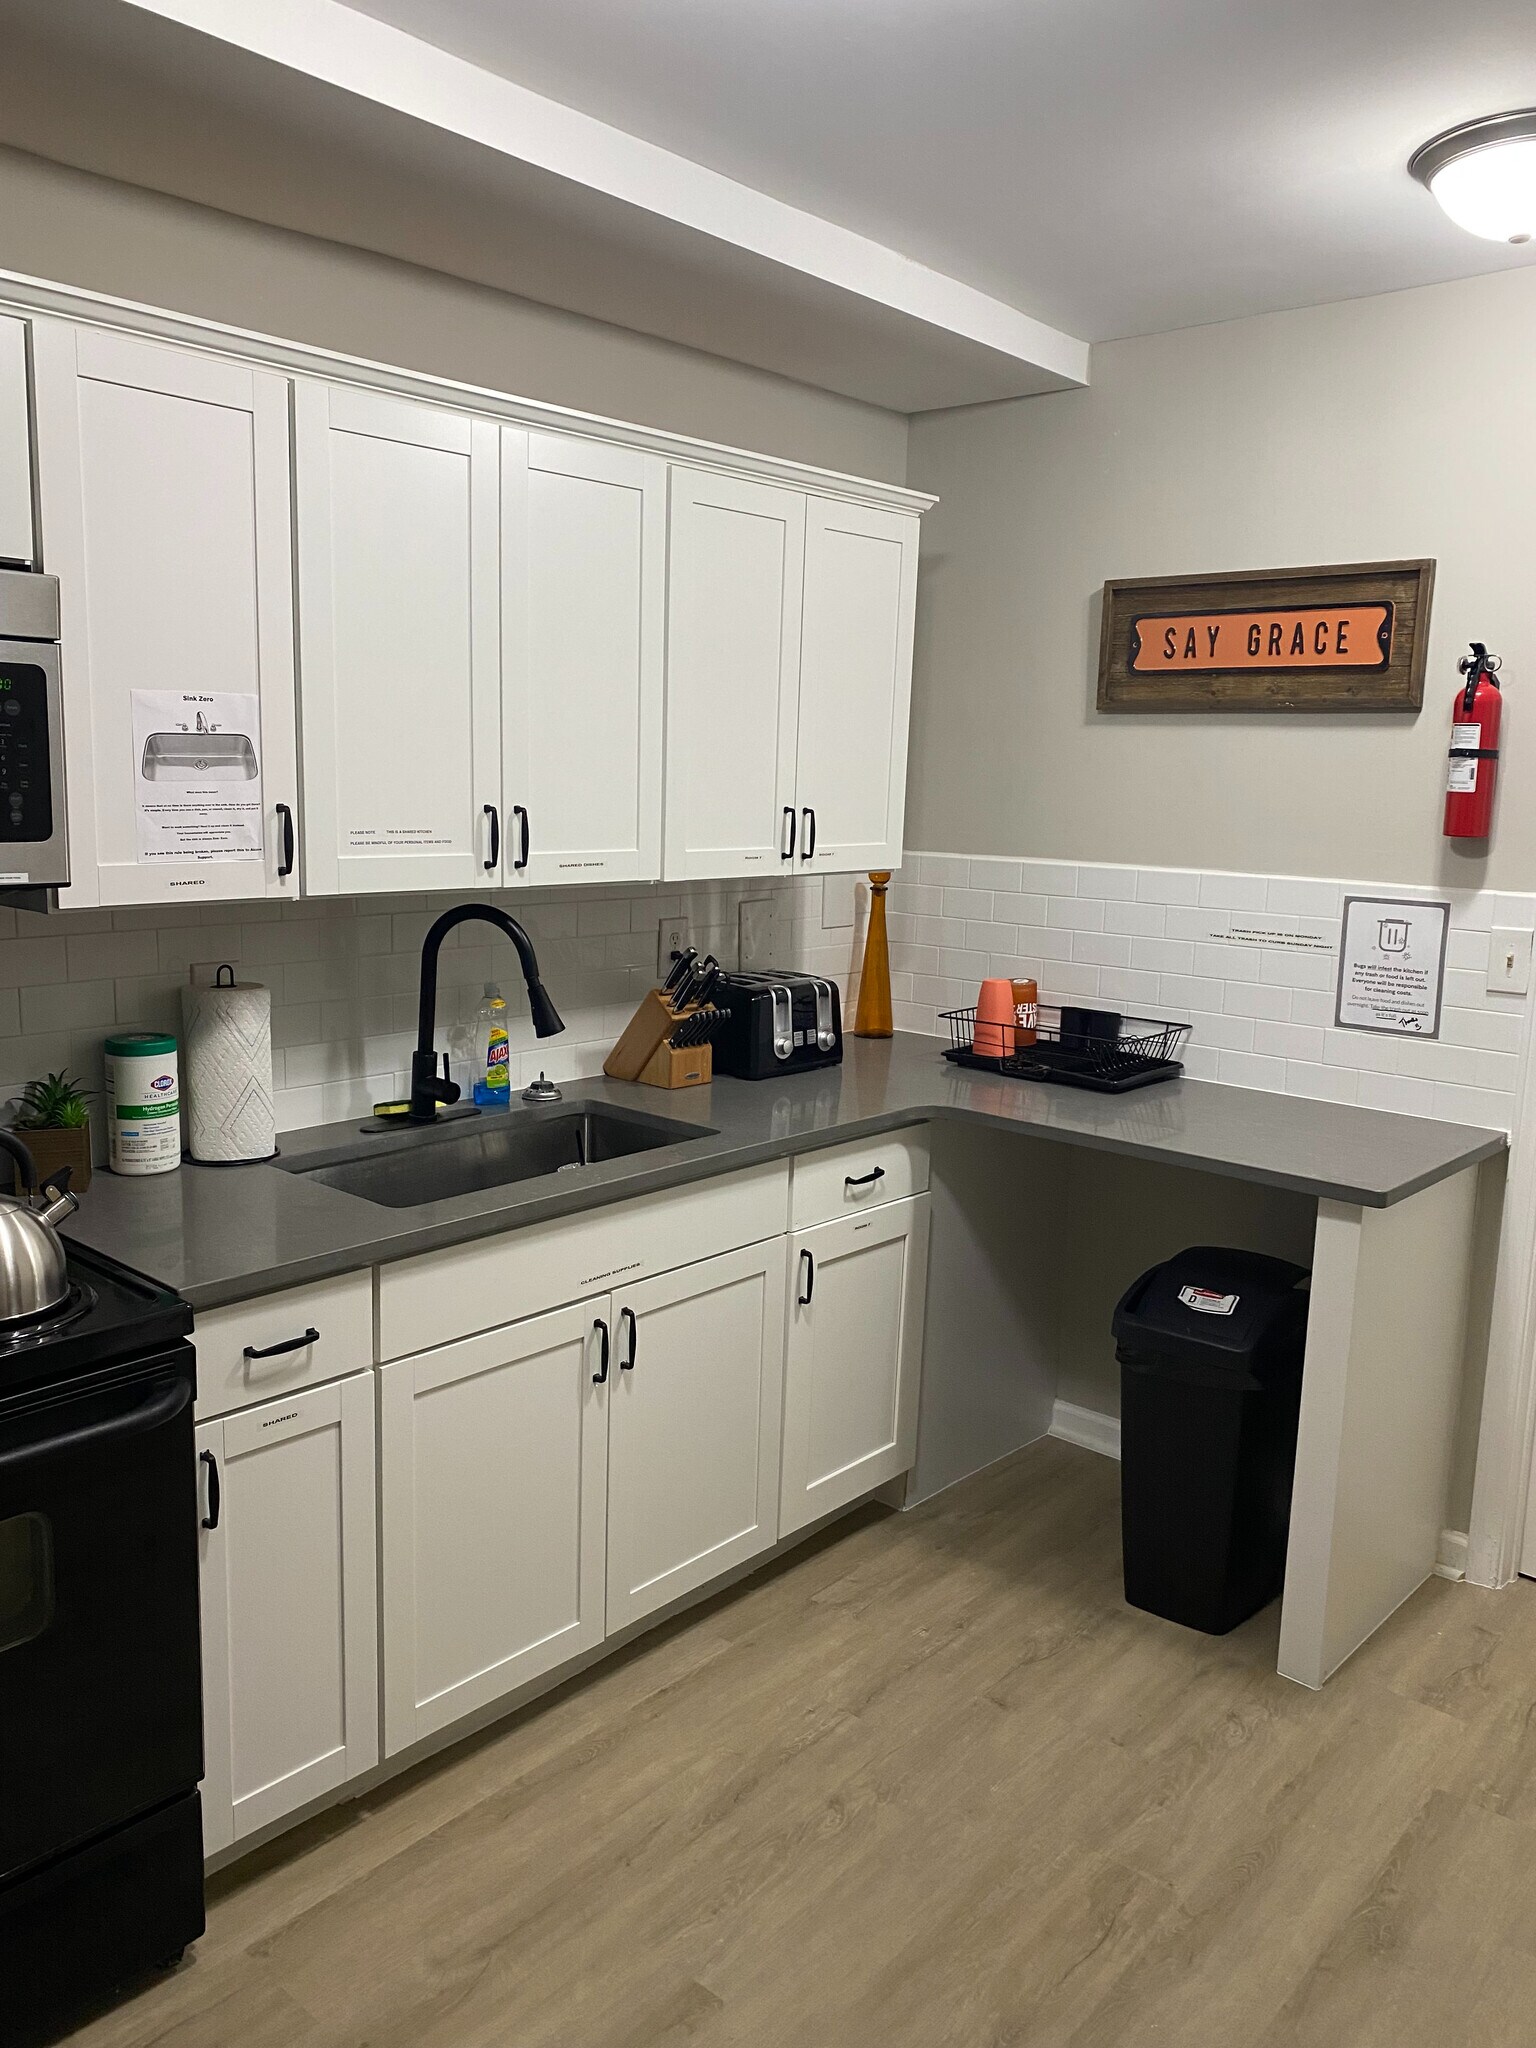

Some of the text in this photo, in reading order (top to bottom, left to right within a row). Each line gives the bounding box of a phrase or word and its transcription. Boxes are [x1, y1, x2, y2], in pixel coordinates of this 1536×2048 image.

[1163, 620, 1350, 660] SAY GRACE
[169, 879, 206, 887] SHARED
[1352, 977, 1376, 985] Everyone
[1373, 987, 1396, 996] cleaning
[489, 1043, 509, 1063] AJAX
[142, 1103, 166, 1112] Hydrogen
[580, 1262, 641, 1285] CLEANING SUPPLIES
[262, 1412, 298, 1428] SHARED
